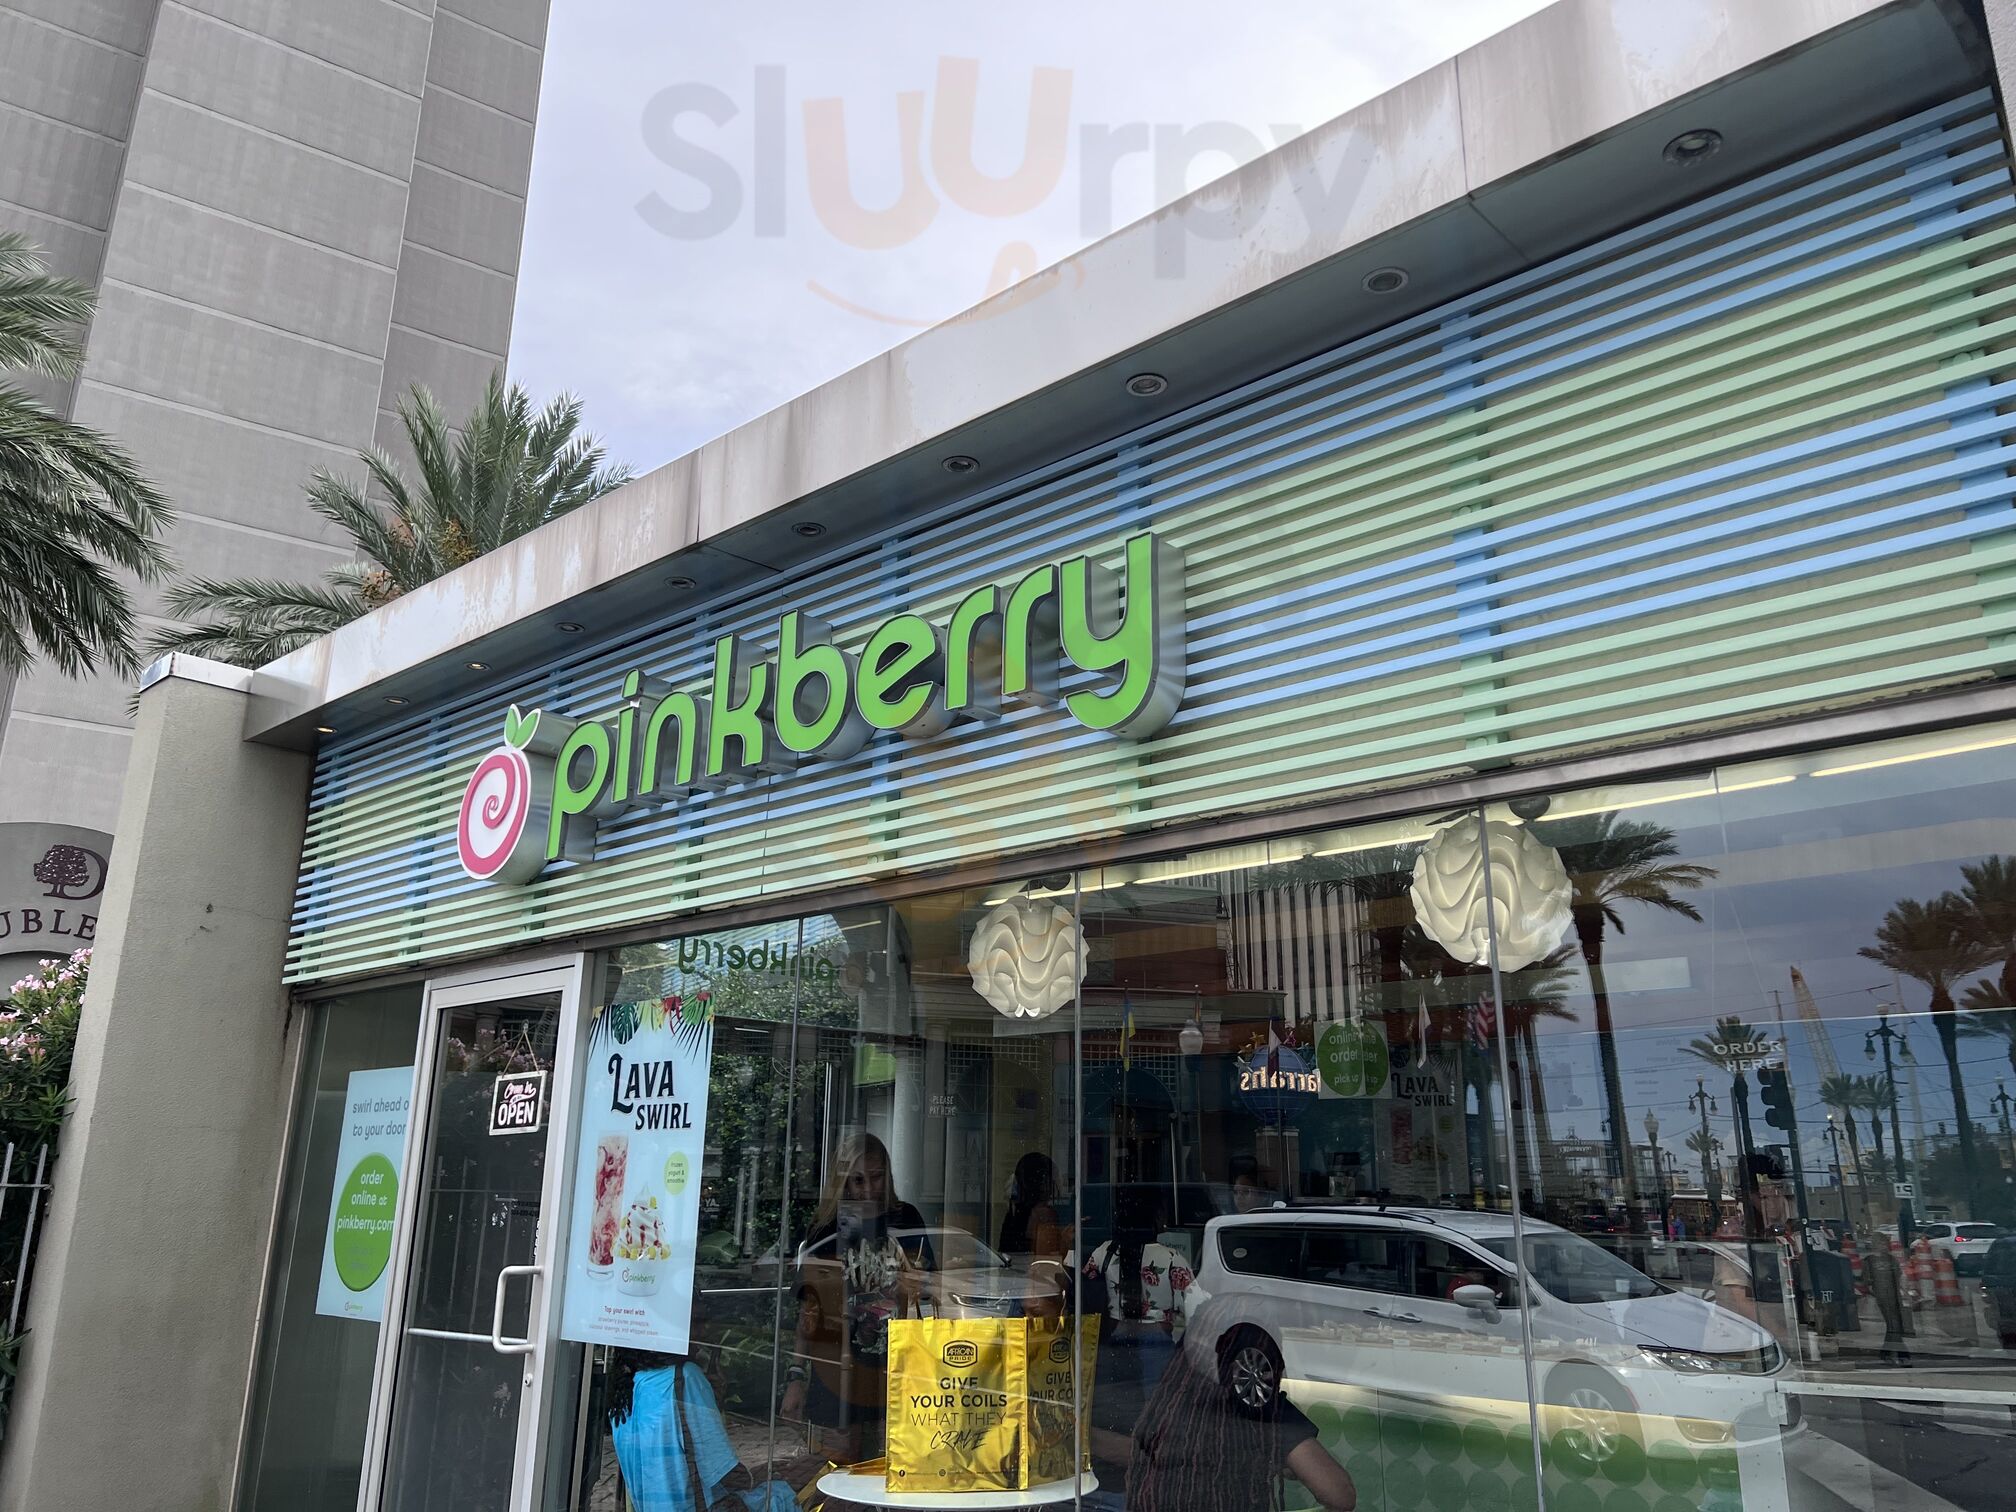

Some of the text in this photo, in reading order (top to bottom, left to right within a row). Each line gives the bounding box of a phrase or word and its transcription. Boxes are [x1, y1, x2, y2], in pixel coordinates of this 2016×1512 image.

[545, 530, 1160, 862] pinkberry
[1713, 1040, 1784, 1055] ORDER
[1727, 1057, 1778, 1071] HERE
[608, 1053, 675, 1113] LAVA
[1390, 1073, 1440, 1099] LAVA
[352, 1098, 372, 1113] swirl
[373, 1096, 402, 1112] ahead
[1414, 1095, 1453, 1107] SWIRL
[498, 1101, 535, 1126] OPEN
[635, 1102, 692, 1130] SWIRL
[352, 1120, 407, 1141] to your door
[360, 1170, 384, 1185] order
[351, 1190, 377, 1206] online
[940, 1377, 979, 1390] GIVE
[1046, 1371, 1072, 1385] GIVE
[911, 1394, 1008, 1408] YOUR COILS
[911, 1411, 1008, 1426] WHAT THEY
